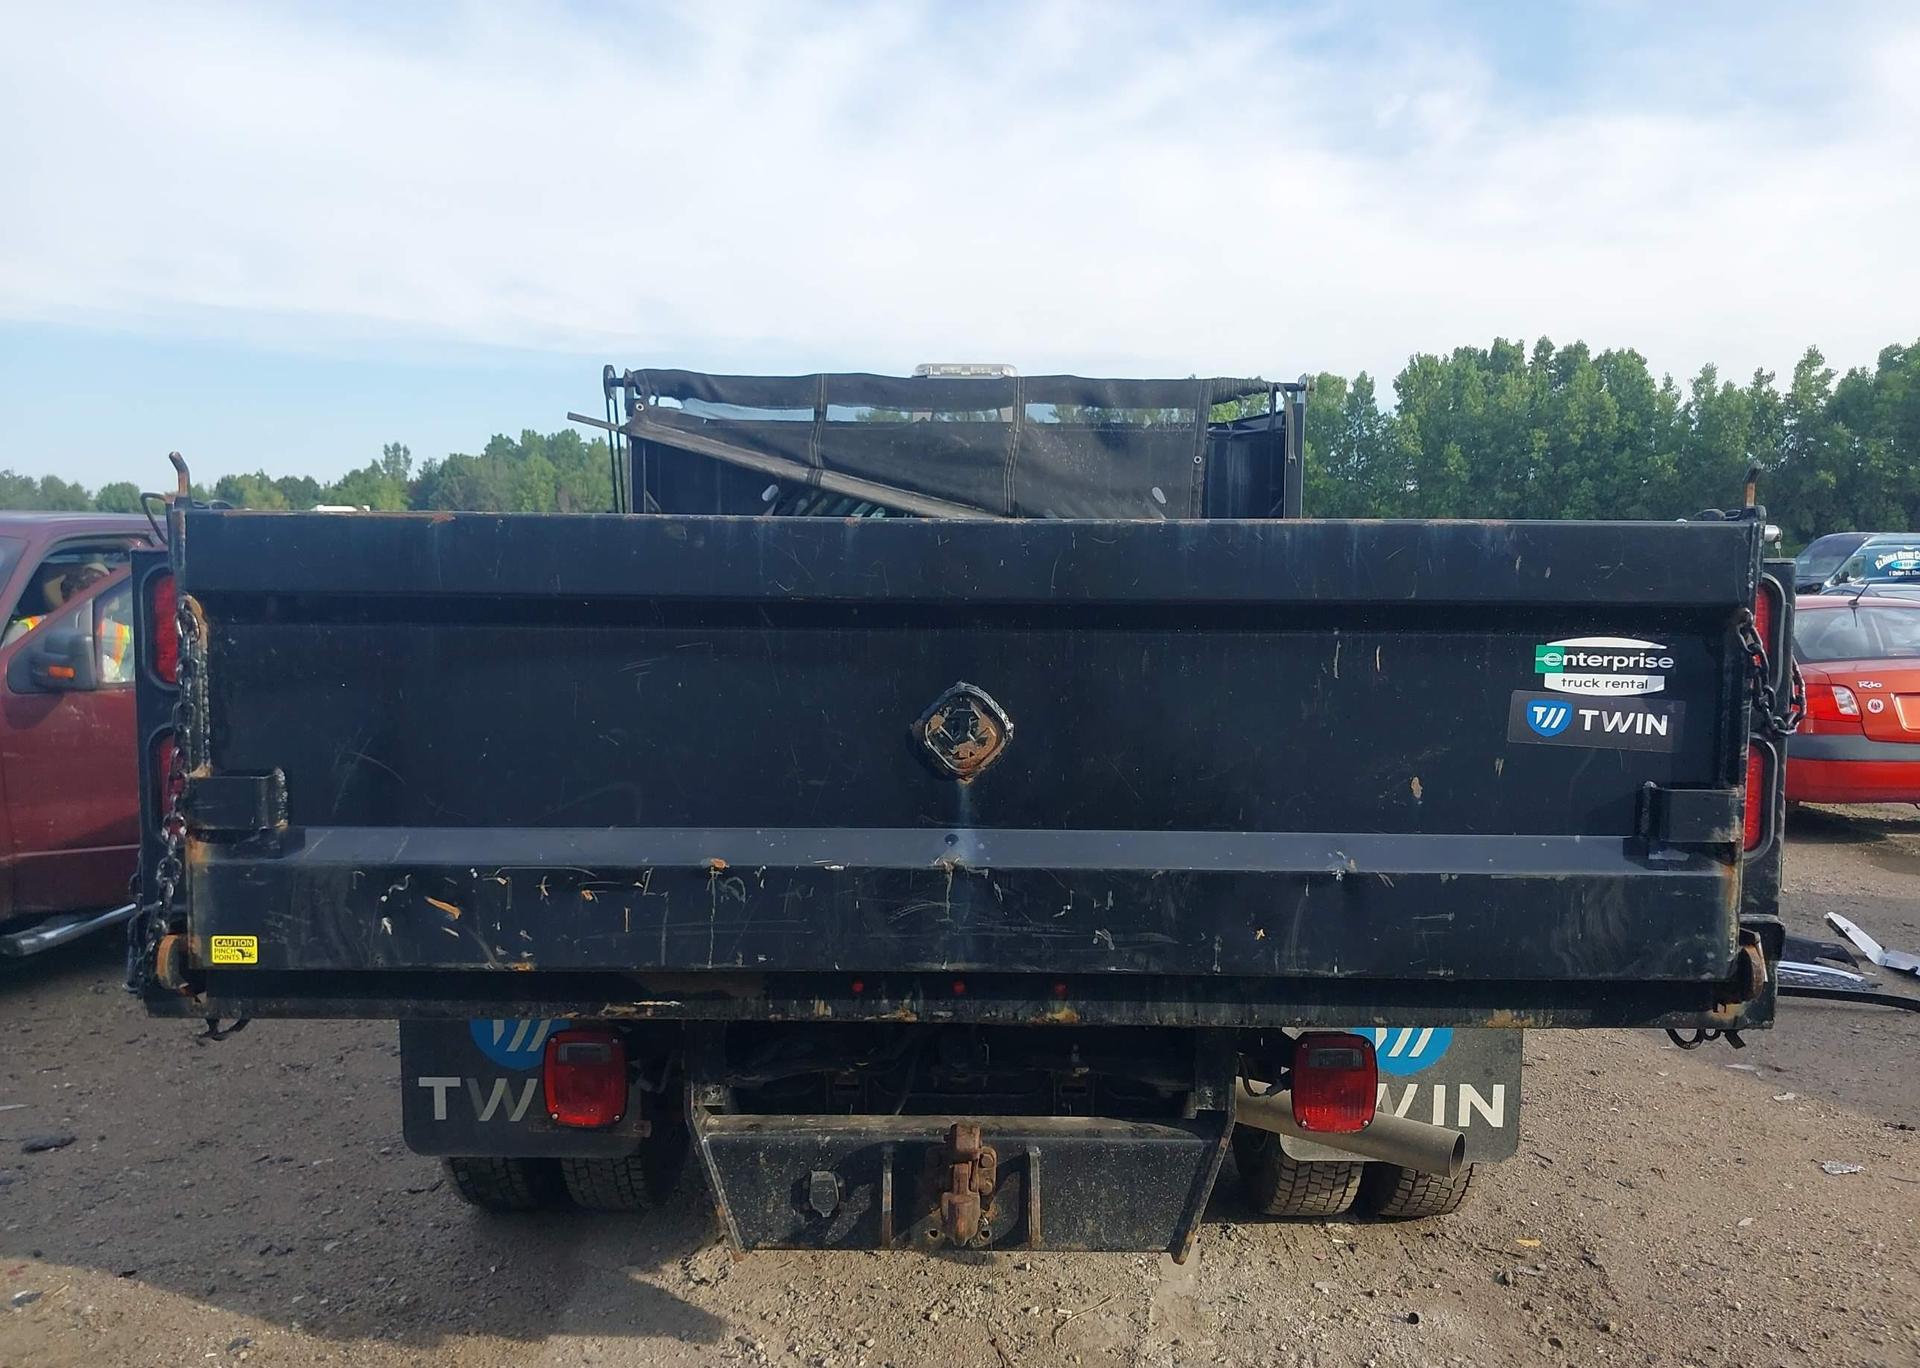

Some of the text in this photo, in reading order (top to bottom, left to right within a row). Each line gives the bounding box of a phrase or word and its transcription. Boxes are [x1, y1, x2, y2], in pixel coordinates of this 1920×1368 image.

[1543, 652, 1674, 671] enterprise
[1561, 677, 1648, 690] truck rental
[1578, 709, 1668, 736] TWIN
[215, 939, 253, 947] CAUTION
[418, 1077, 538, 1122] TW
[1377, 1083, 1505, 1128] WIN
